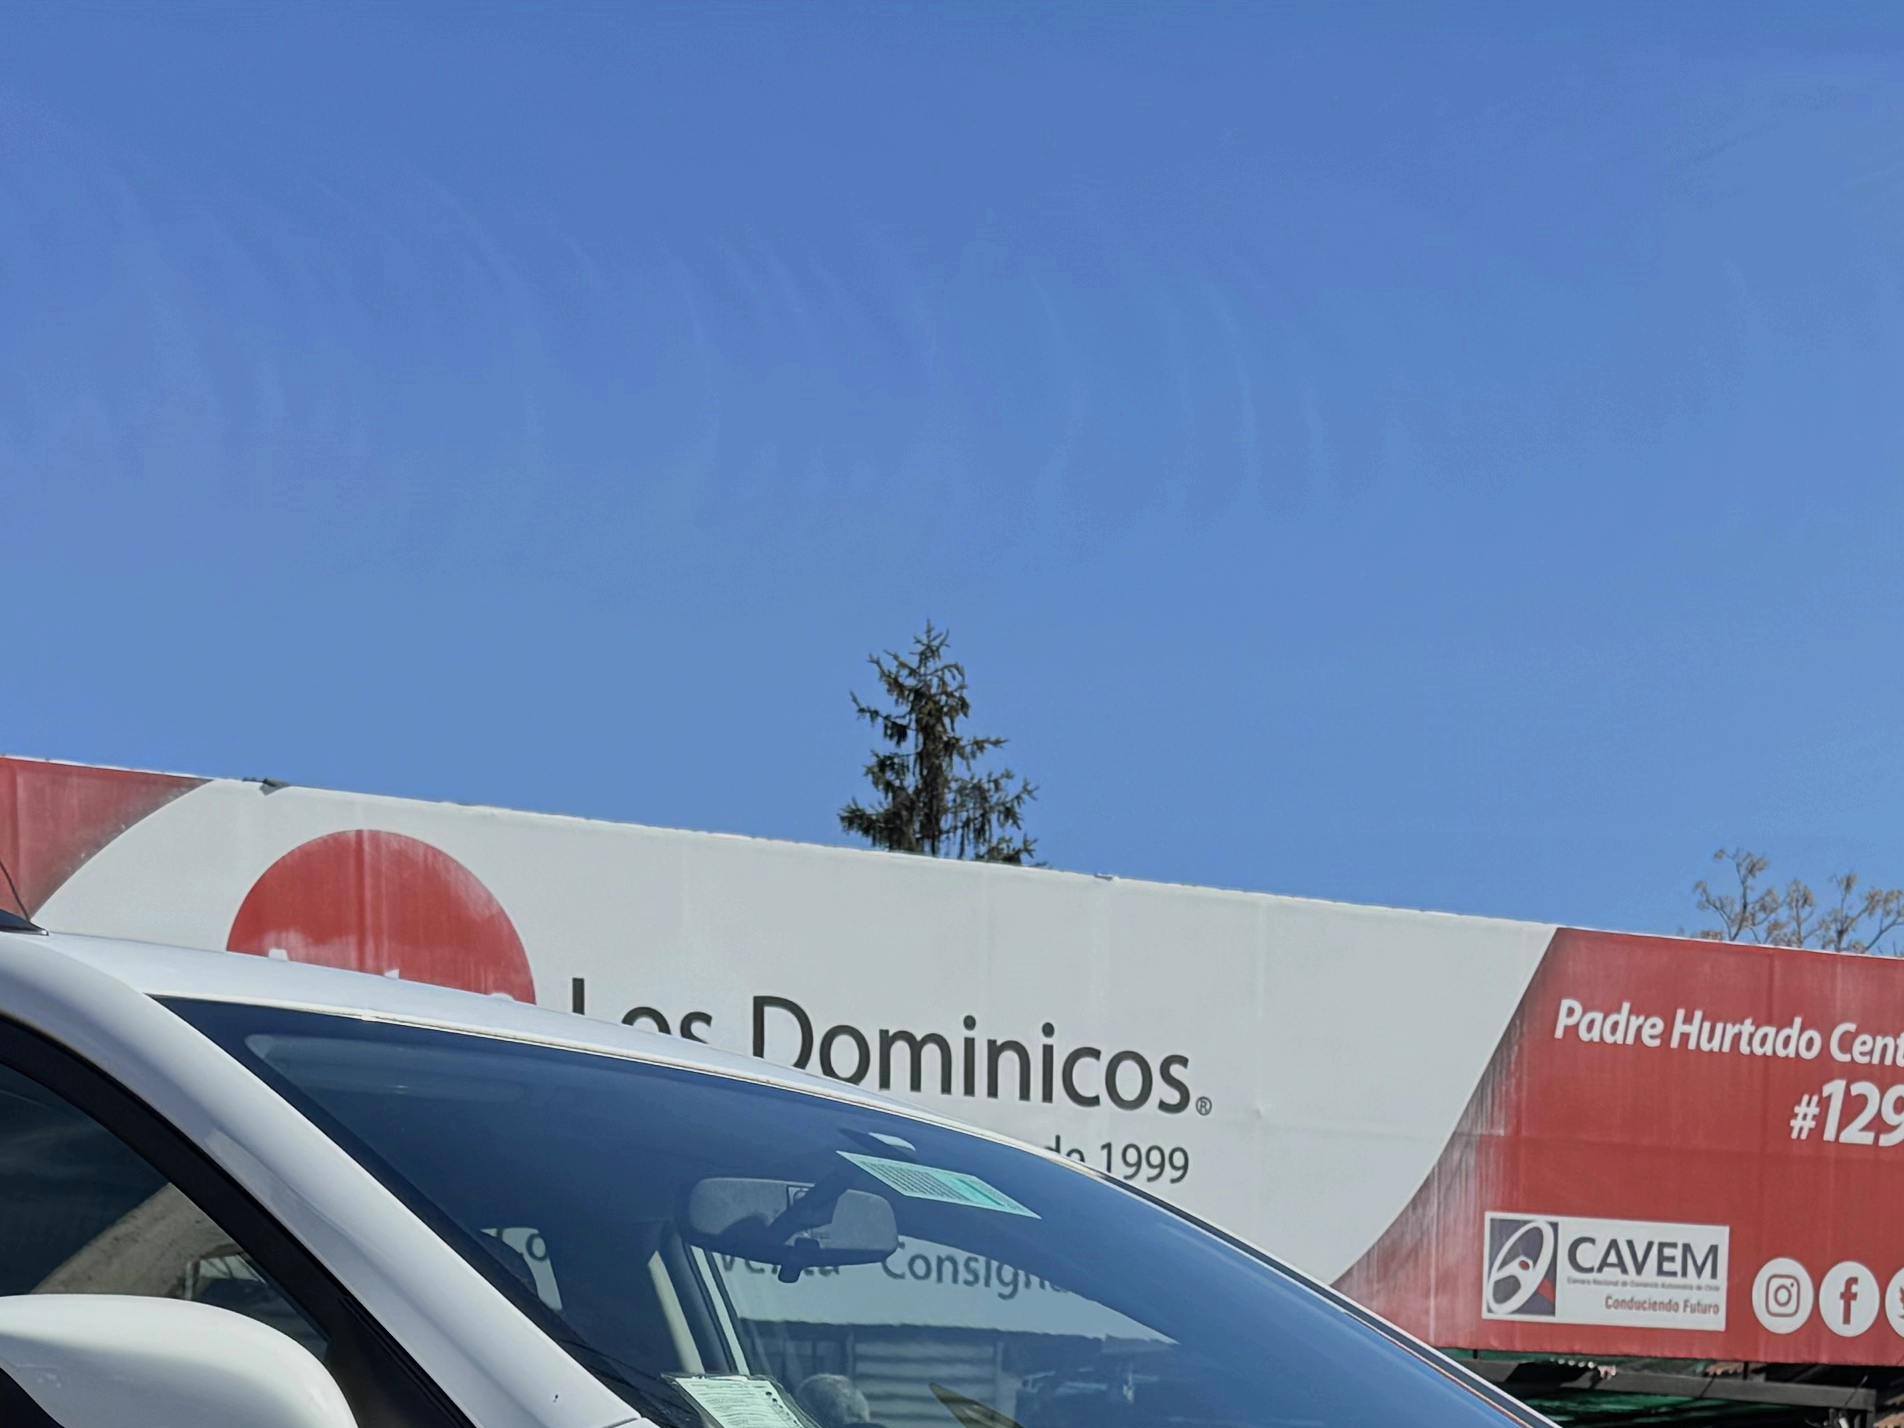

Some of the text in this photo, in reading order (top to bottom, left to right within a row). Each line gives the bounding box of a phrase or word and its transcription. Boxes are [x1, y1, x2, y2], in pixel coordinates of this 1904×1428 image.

[1555, 999, 1664, 1047] Padre
[1670, 1009, 1822, 1060] Hurtado
[1101, 1142, 1190, 1184] 1999
[1567, 1236, 1719, 1280] CAVEM
[1604, 1295, 1720, 1316] Conduciendo Futuro
